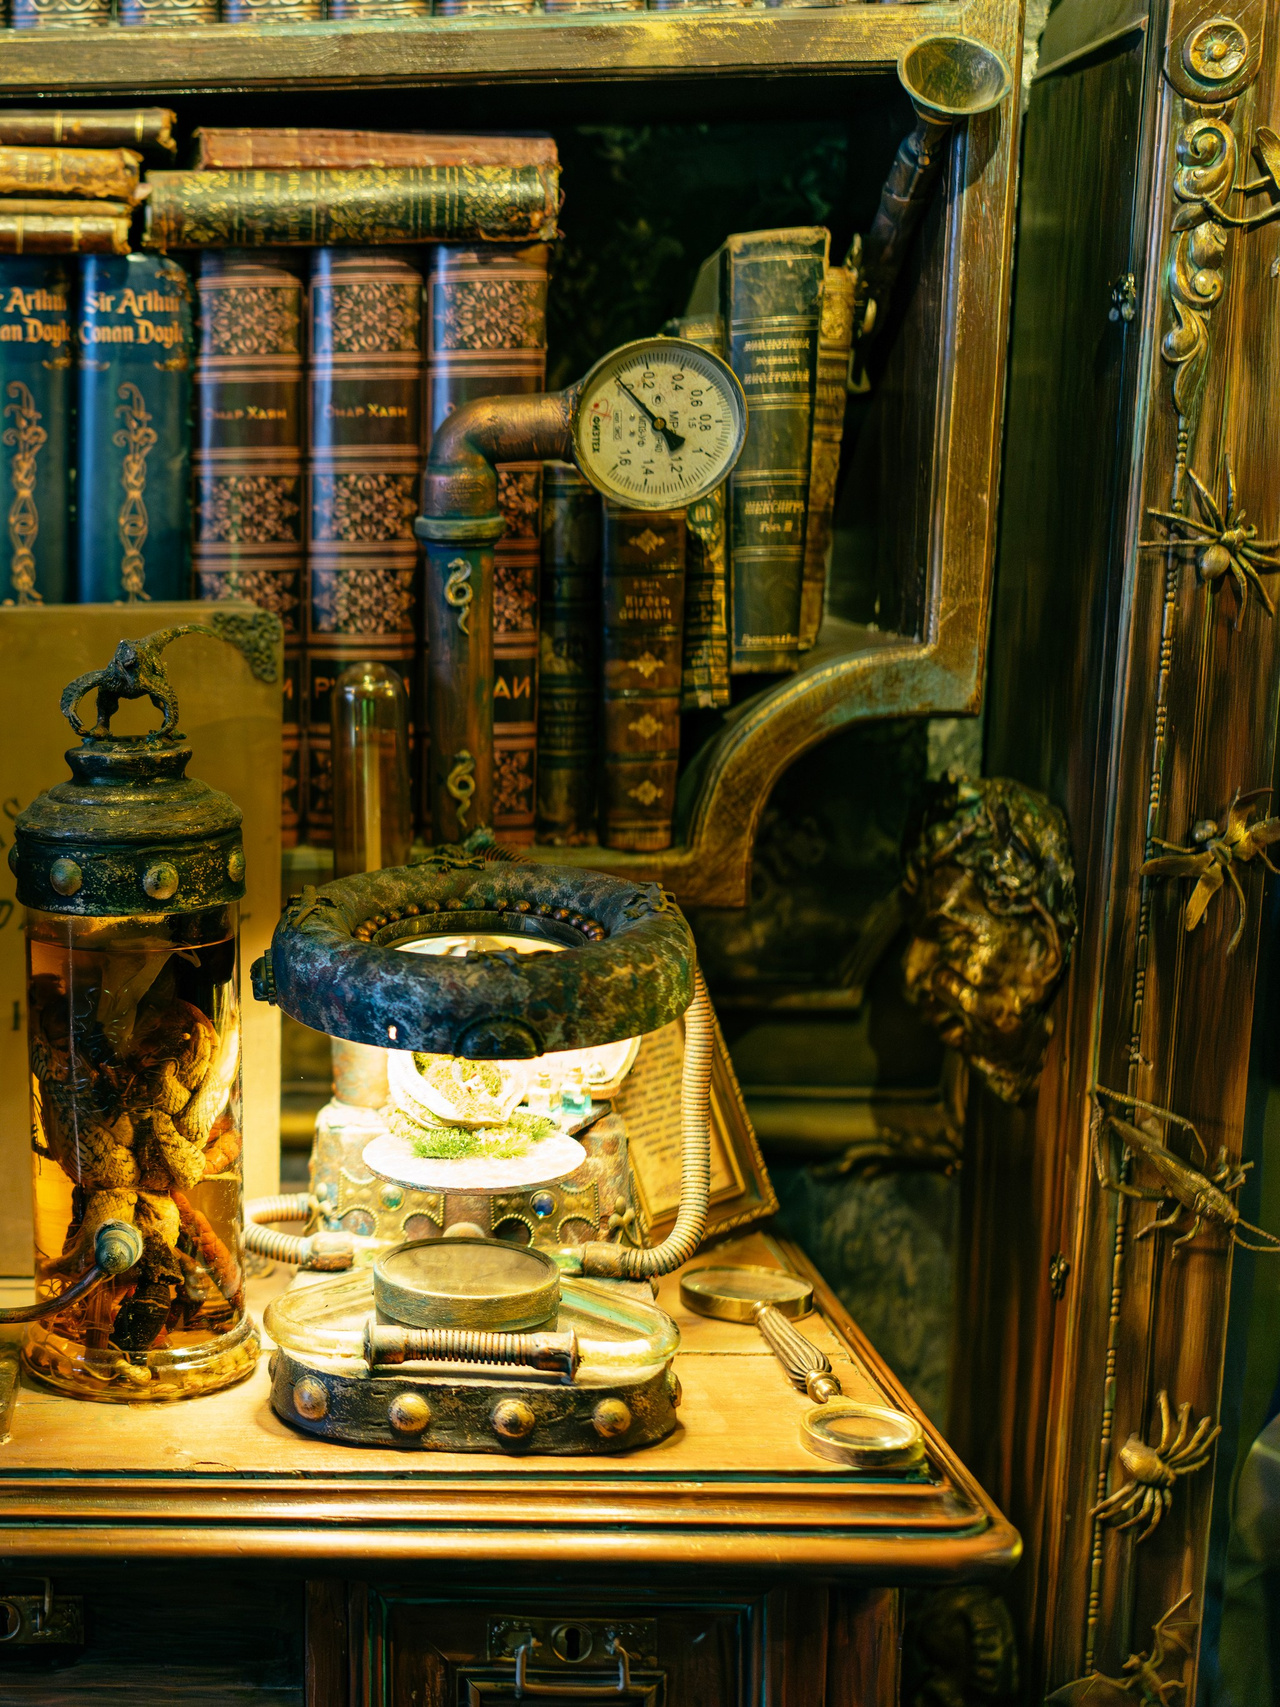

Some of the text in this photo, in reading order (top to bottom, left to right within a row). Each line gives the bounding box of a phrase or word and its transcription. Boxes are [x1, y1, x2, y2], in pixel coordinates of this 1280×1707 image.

[84, 288, 111, 314] Sir
[78, 320, 133, 345] Conan
[672, 372, 685, 392] 0,4
[690, 389, 703, 408] 0,6
[699, 413, 712, 432] 0,8
[618, 448, 632, 467] 1,6
[643, 458, 655, 476] 1,4
[670, 456, 683, 475] 1,2
